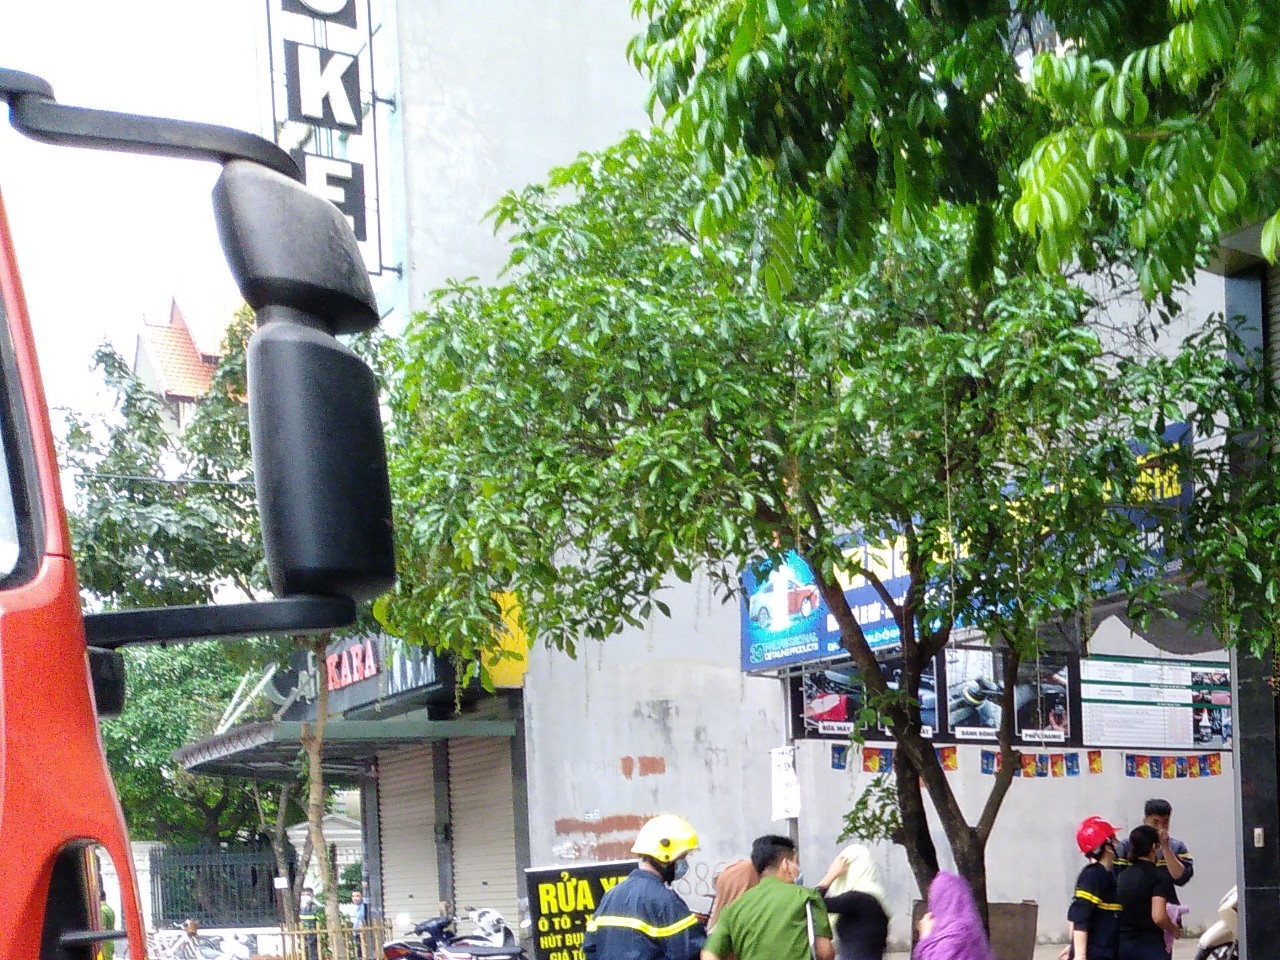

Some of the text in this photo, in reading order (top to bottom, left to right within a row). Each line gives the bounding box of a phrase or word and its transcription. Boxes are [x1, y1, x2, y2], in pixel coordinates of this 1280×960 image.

[298, 0, 356, 231] KE
[538, 871, 594, 915] RỬA
[552, 914, 571, 931] TÔ
